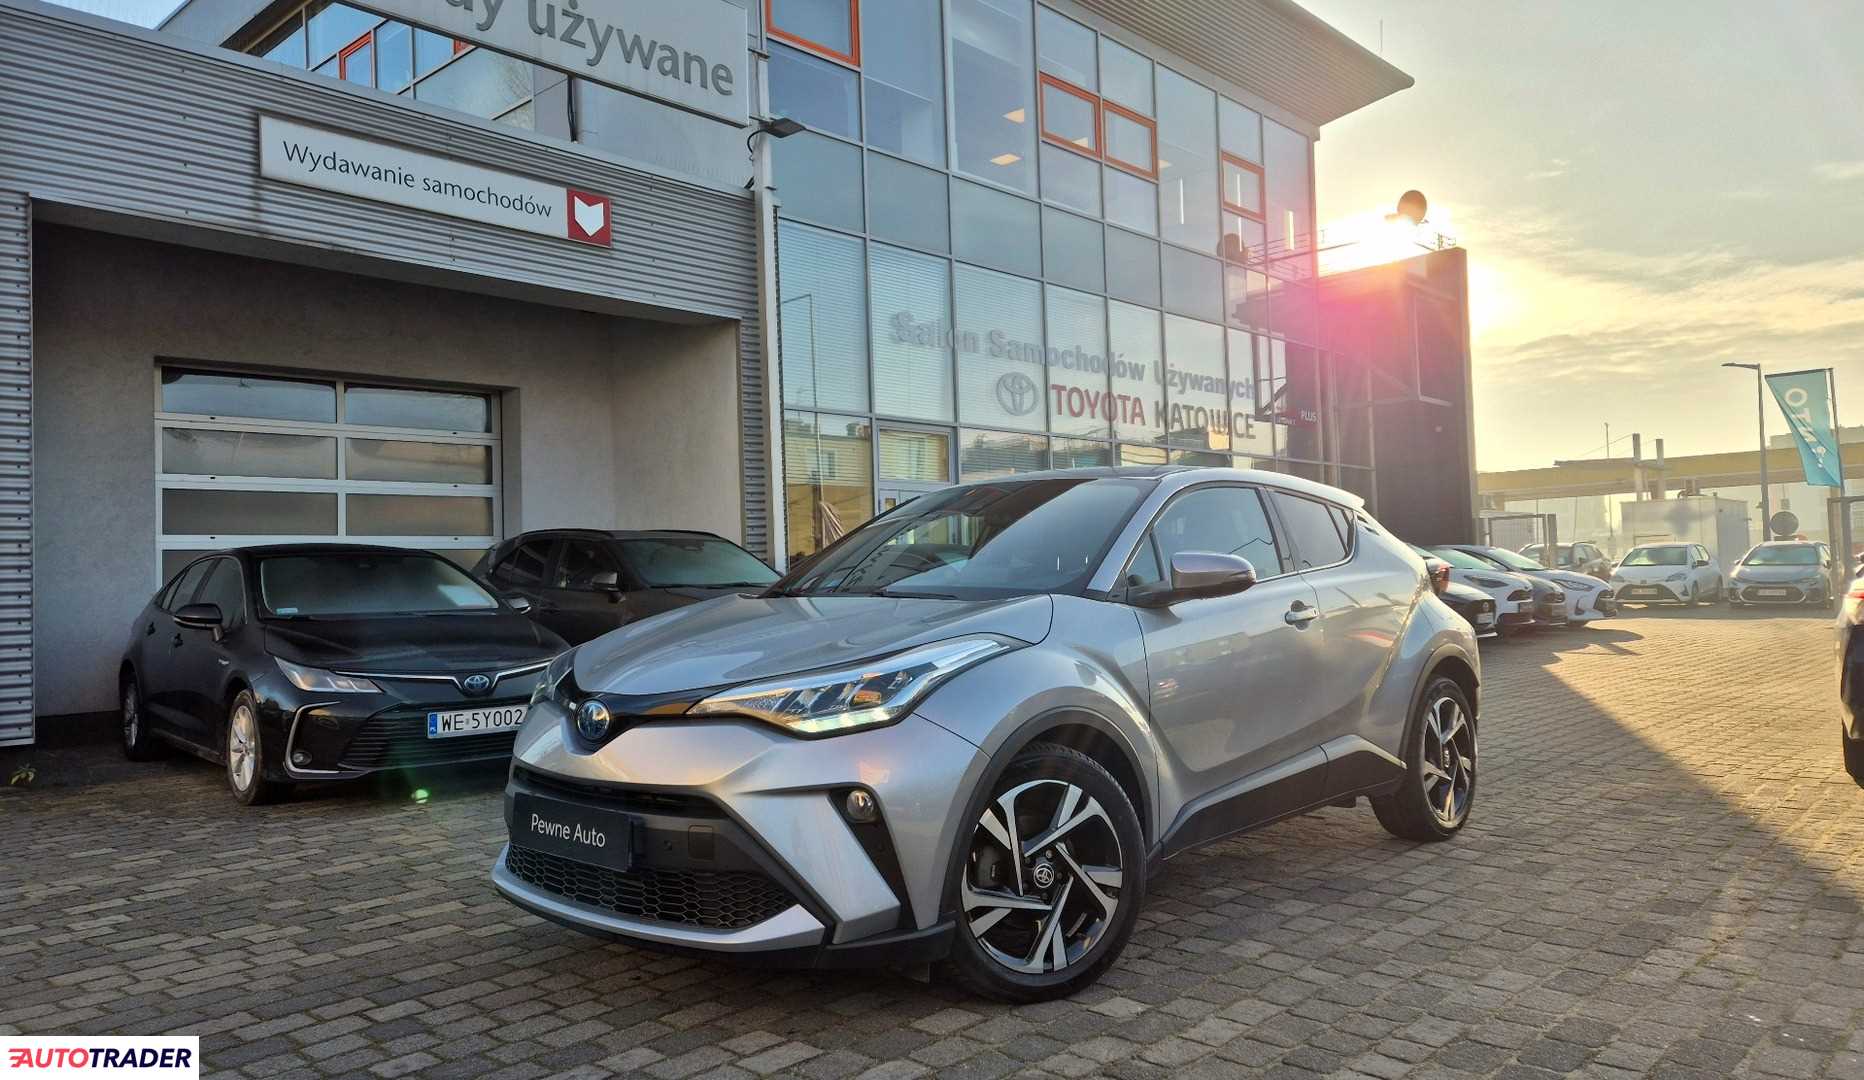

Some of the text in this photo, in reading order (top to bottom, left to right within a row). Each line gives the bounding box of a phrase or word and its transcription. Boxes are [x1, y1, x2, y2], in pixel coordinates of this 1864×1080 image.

[527, 0, 734, 96] używane
[283, 140, 552, 217] Wydawanie samochodów
[889, 311, 1256, 400] Salon Samochodów Używanych
[1051, 383, 1257, 440] TOYOTA KATOWICE
[441, 713, 464, 732] WE
[471, 709, 523, 729] 5Y002
[531, 813, 606, 848] Pewne Auto
